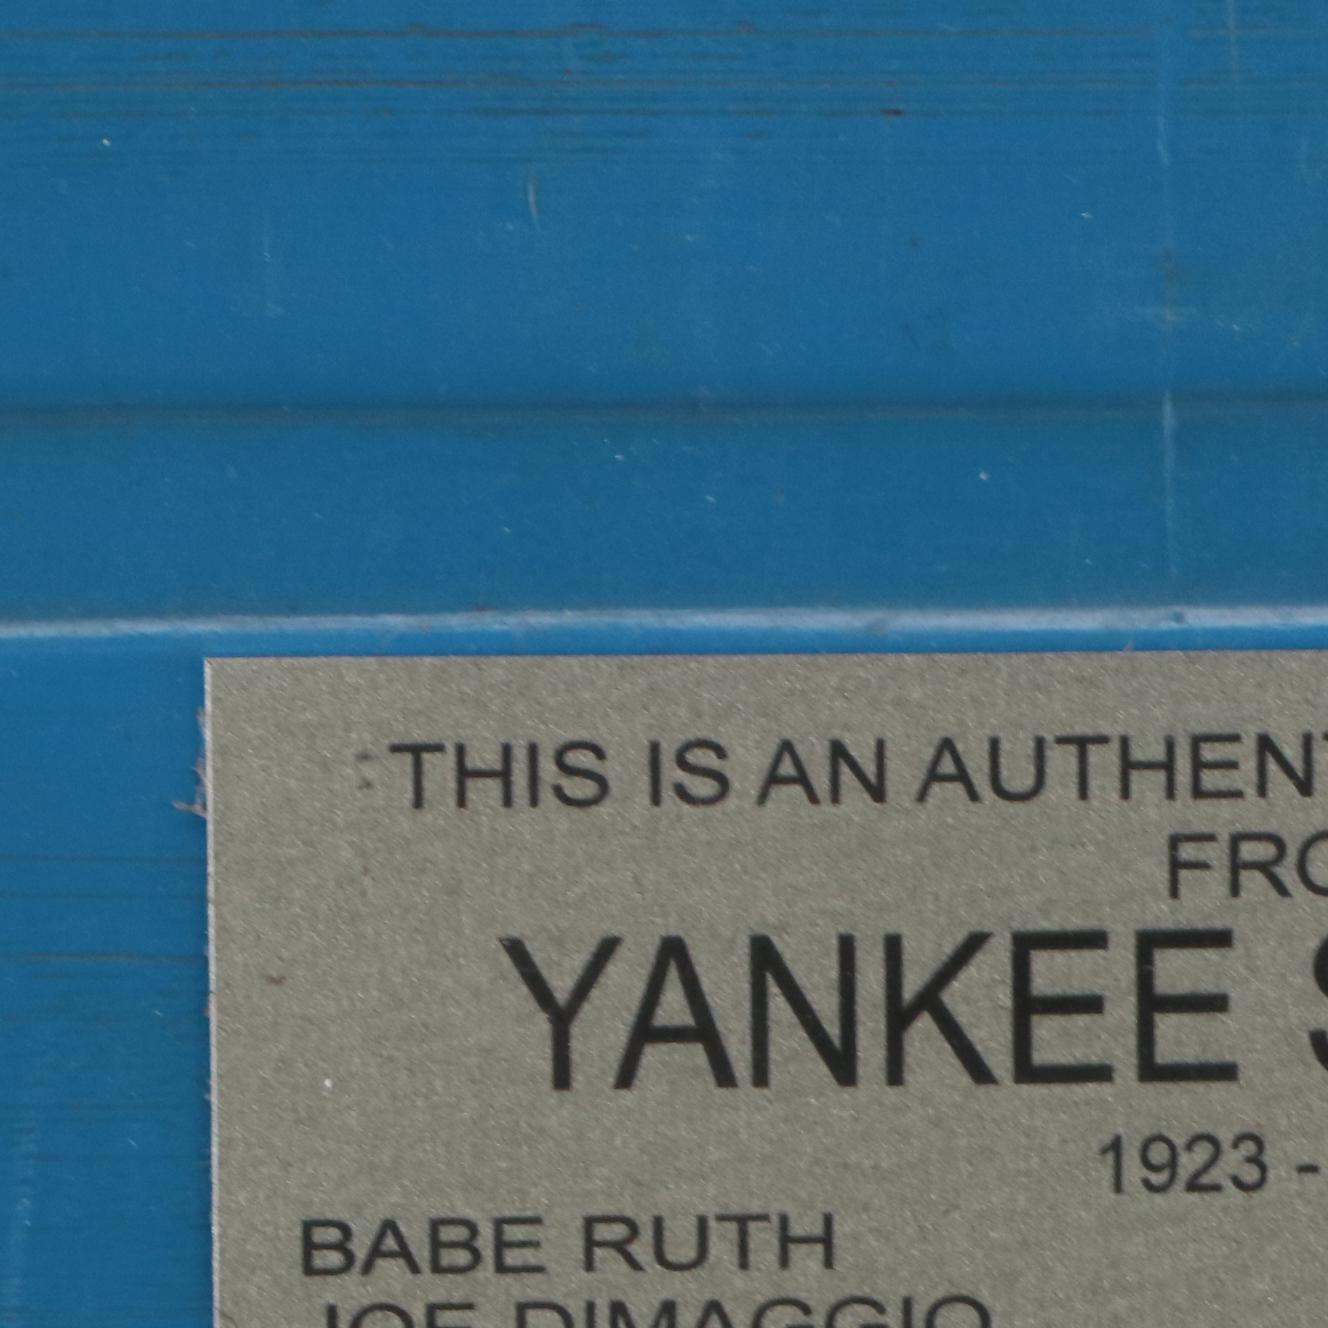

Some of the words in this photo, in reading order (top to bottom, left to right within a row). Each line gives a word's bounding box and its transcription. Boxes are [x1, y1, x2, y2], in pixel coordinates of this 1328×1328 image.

[388, 740, 610, 811] THIS
[648, 738, 731, 807] IS
[756, 738, 888, 806] AN
[500, 926, 1240, 1092] YANKEE
[1099, 1131, 1269, 1195] 1923
[300, 1215, 546, 1278] BABE
[582, 1212, 835, 1273] RUTH
